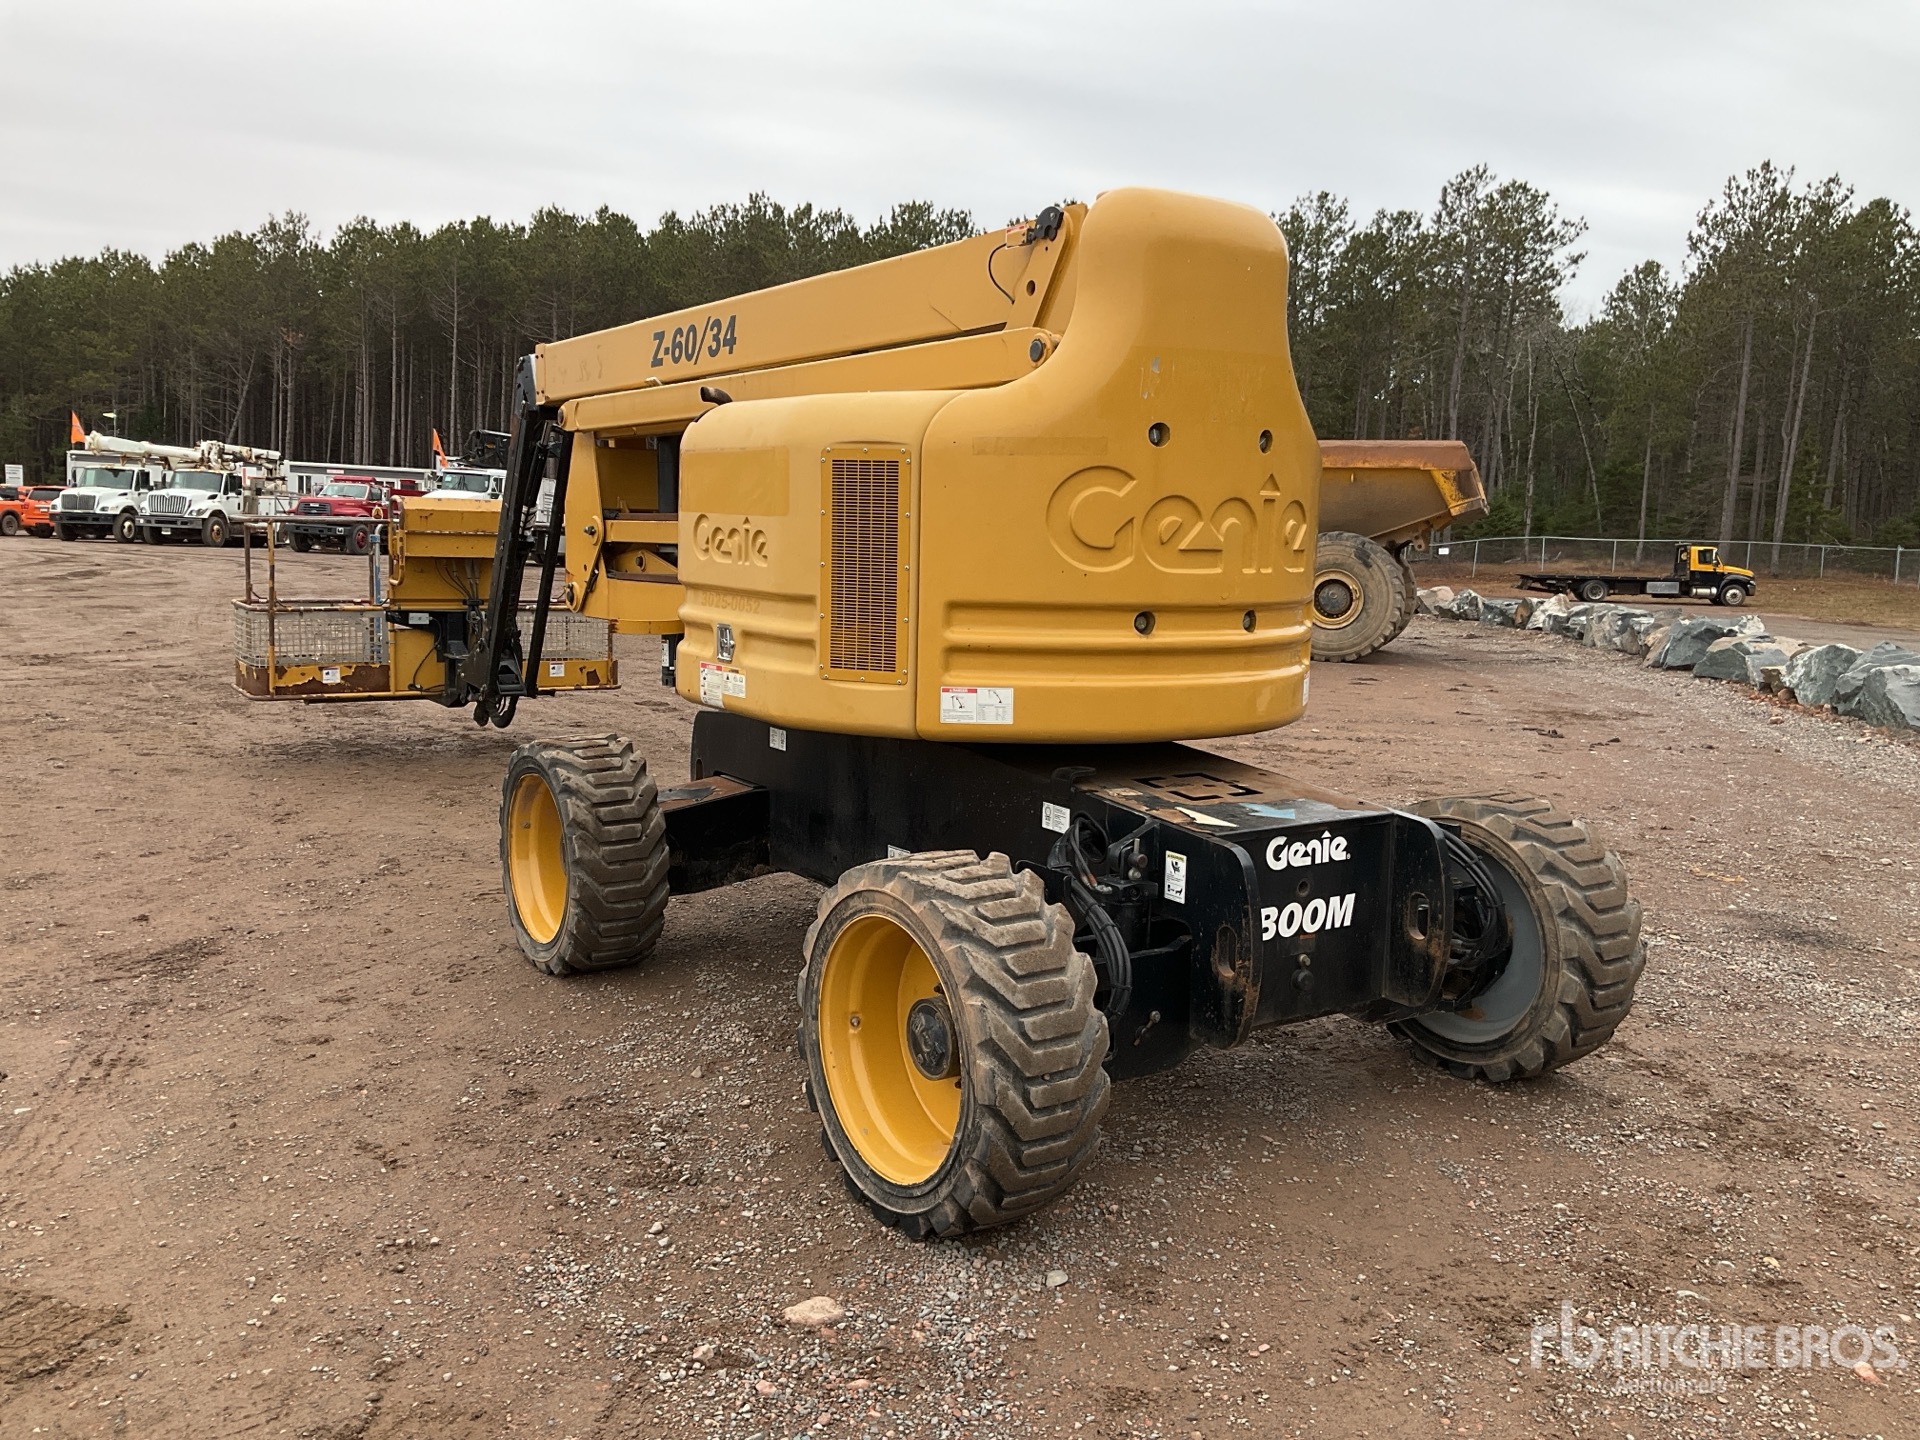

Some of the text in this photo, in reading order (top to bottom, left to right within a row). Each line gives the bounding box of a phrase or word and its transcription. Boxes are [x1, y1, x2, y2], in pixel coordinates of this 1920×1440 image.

[651, 314, 737, 368] Z-60/34
[693, 514, 768, 568] Genie
[1046, 465, 1308, 573] Genie
[1266, 830, 1349, 871] Genie
[1261, 893, 1356, 941] BOOM
